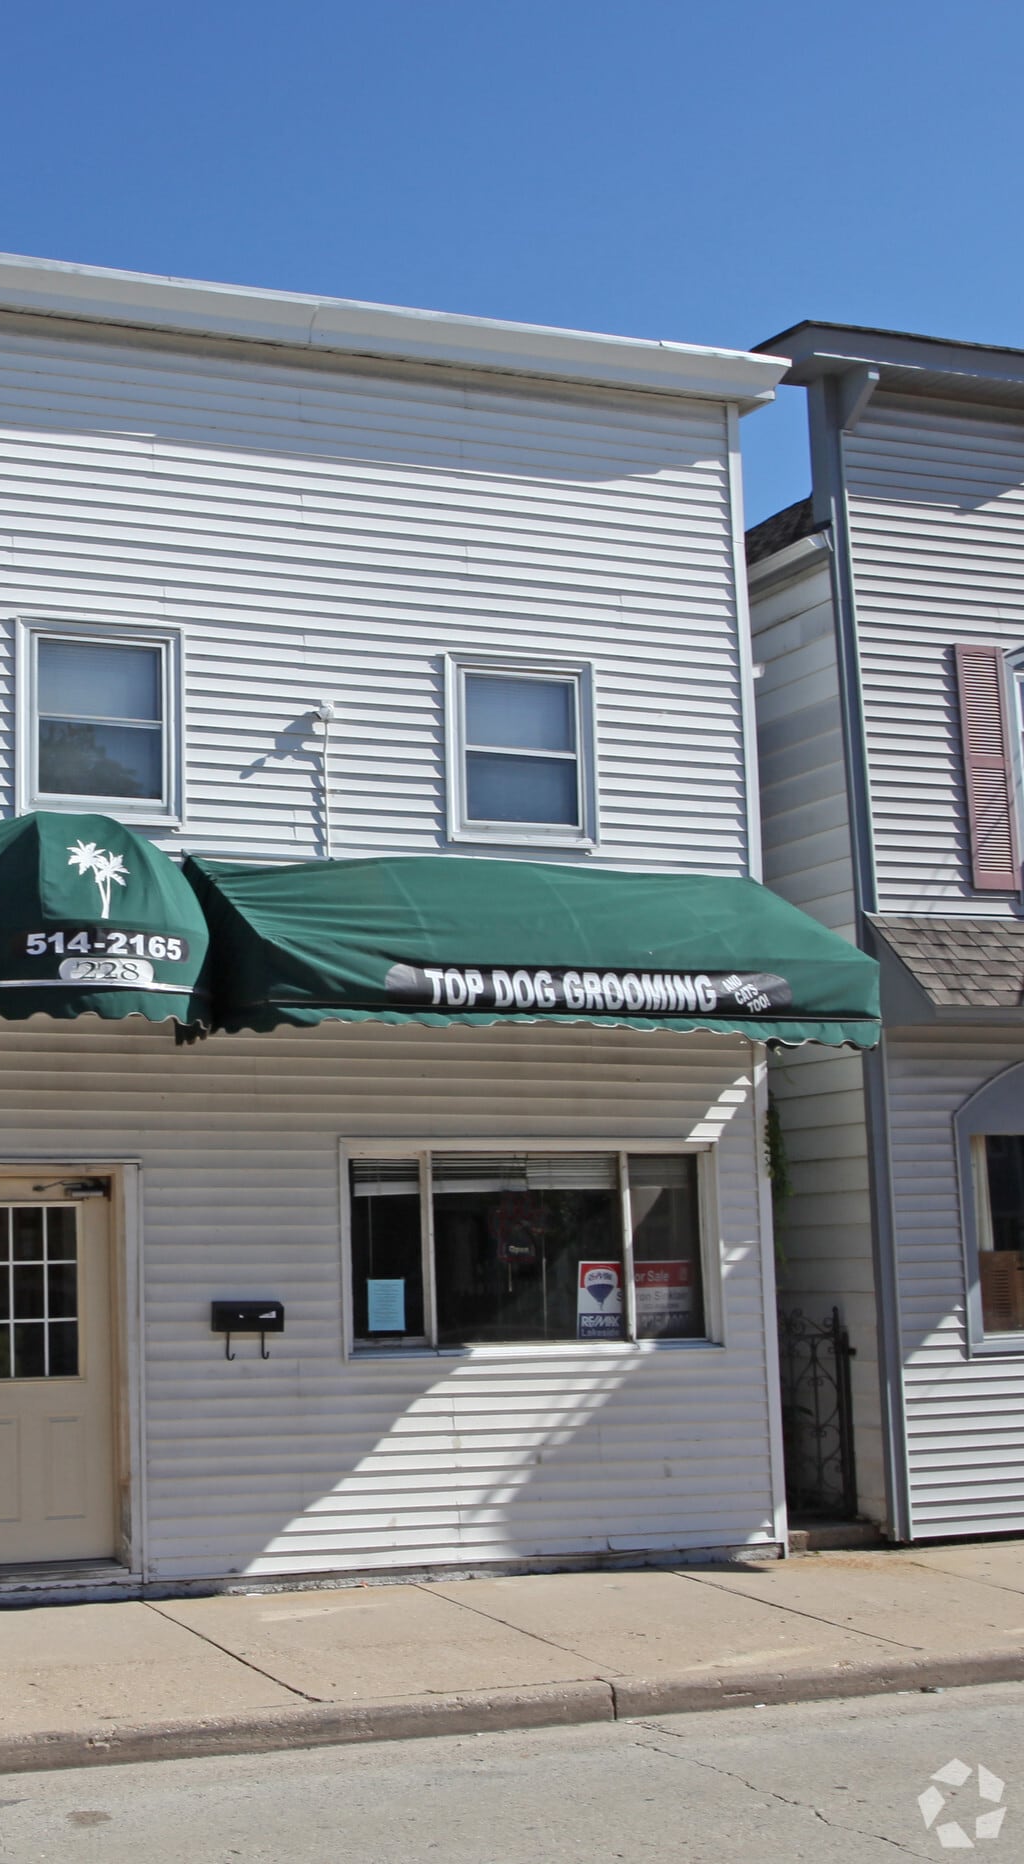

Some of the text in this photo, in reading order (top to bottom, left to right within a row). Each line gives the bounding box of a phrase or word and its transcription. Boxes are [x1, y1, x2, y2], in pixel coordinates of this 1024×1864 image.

[26, 931, 182, 961] 514-2165
[75, 960, 140, 981] 228
[423, 968, 717, 1013] TOP DOG GROOMING
[722, 974, 743, 992] AND
[734, 983, 759, 1005] CATS
[746, 993, 772, 1013] TOO!
[647, 1269, 670, 1282] Sale
[580, 1314, 621, 1327] RE/MAX
